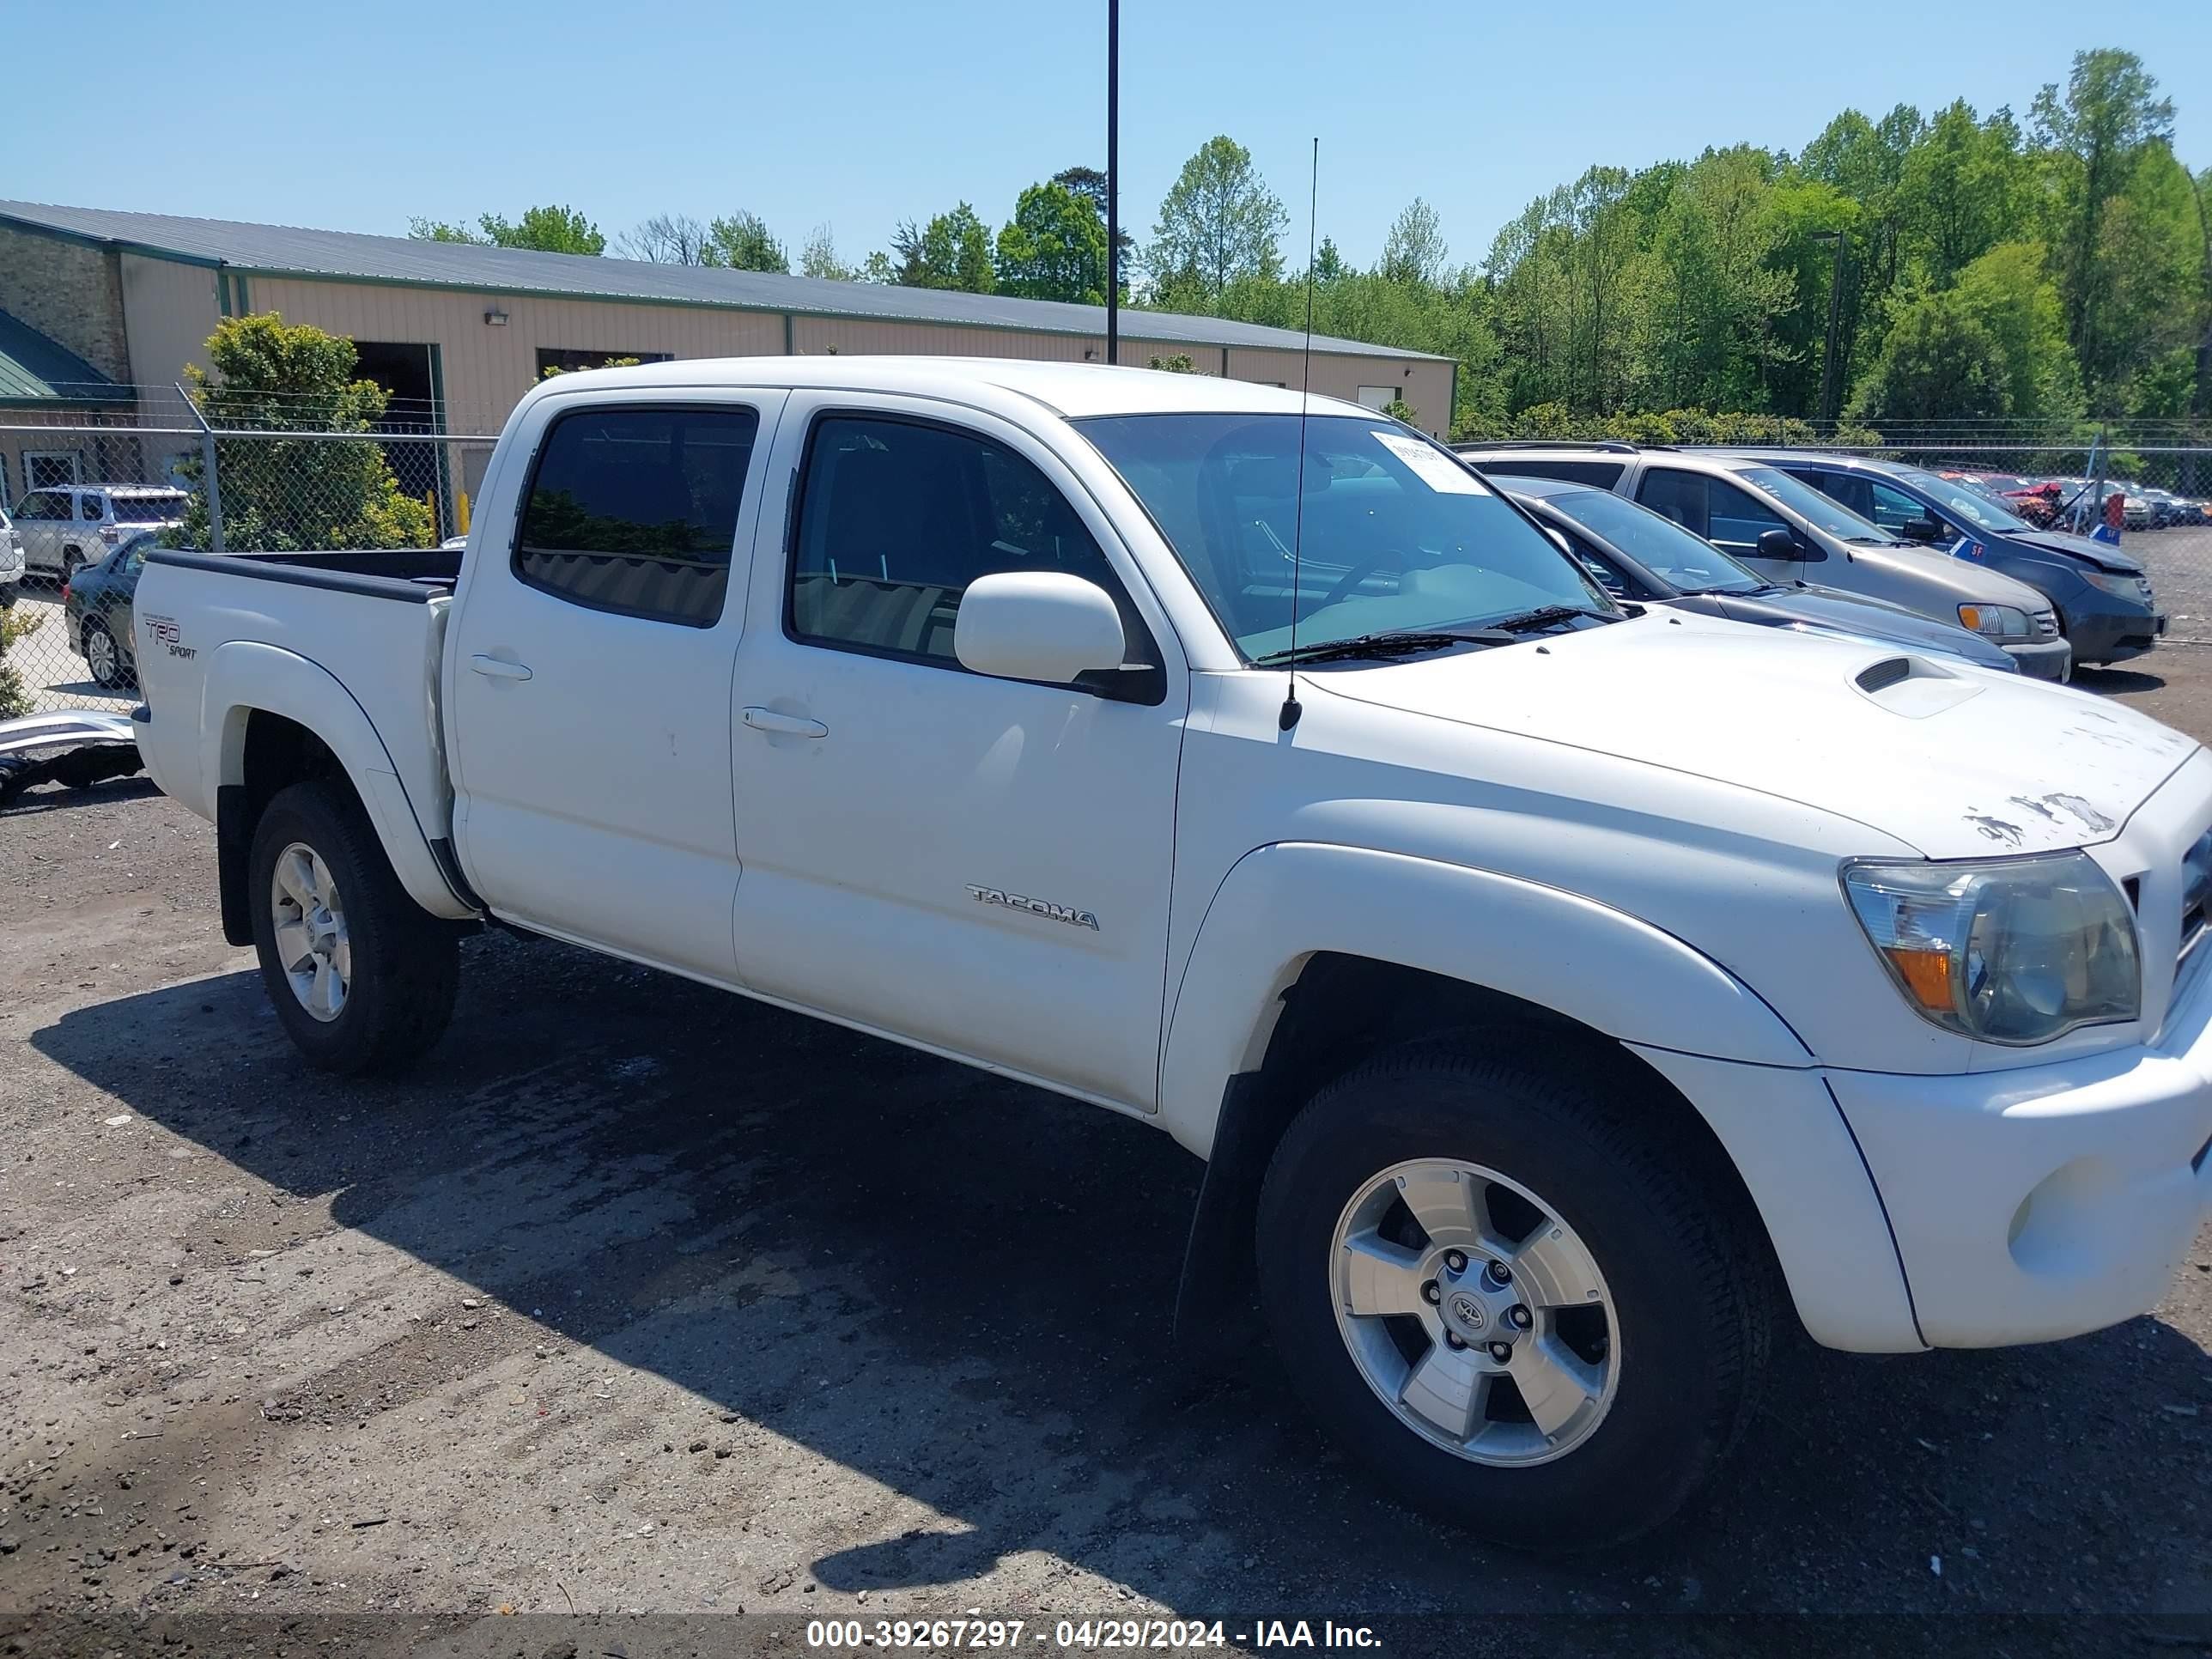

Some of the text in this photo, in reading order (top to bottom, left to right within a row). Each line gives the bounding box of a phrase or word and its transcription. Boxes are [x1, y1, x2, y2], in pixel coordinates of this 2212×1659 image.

[1971, 544, 1984, 556] SF
[145, 618, 179, 647] TRD
[169, 645, 198, 660] SPORT
[964, 883, 1100, 932] TACOMA
